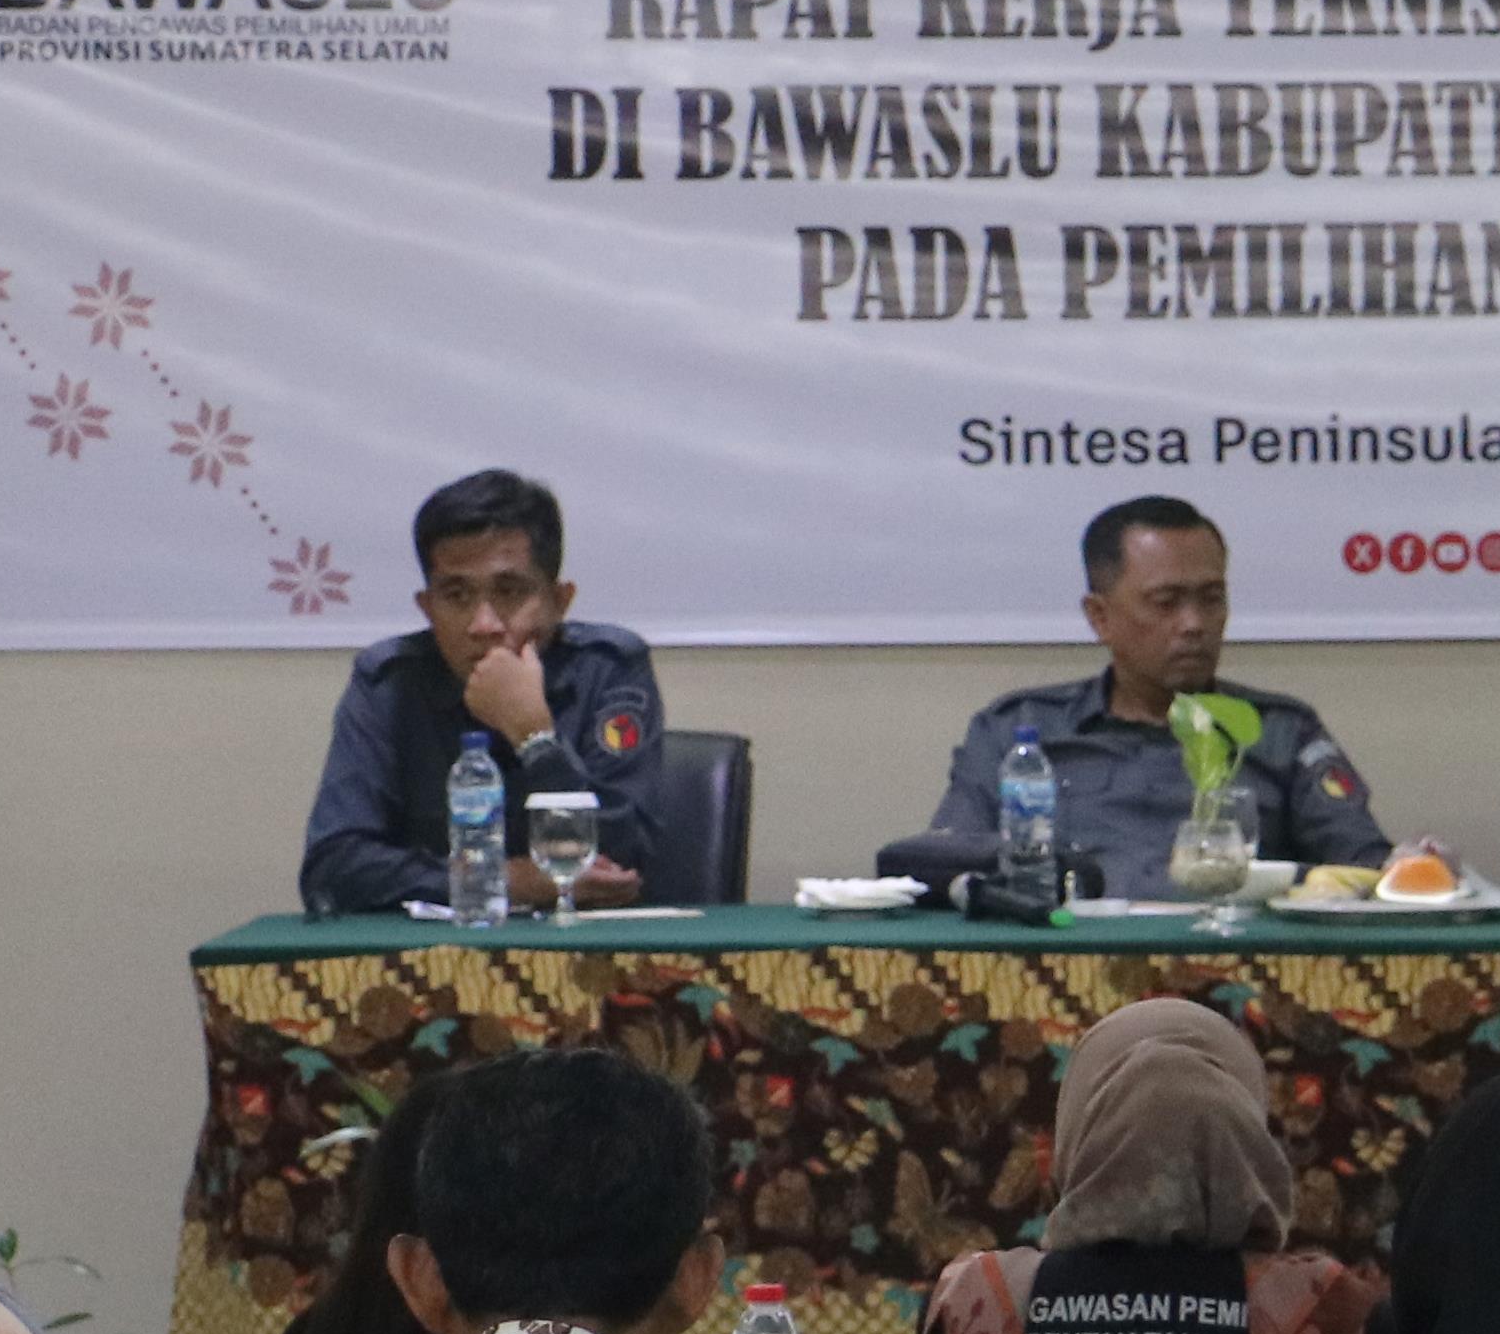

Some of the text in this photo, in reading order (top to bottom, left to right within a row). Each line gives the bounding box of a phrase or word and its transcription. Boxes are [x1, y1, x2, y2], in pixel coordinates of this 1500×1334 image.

[0, 38, 449, 62] PROVINSI SUMATERA SELATAN
[234, 15, 367, 36] PEMILIHAN
[373, 15, 450, 35] UMUM
[546, 87, 644, 181] DI
[674, 82, 1063, 181] BAWASLU
[795, 224, 1028, 322] PADA
[958, 414, 1191, 466] Sintesa
